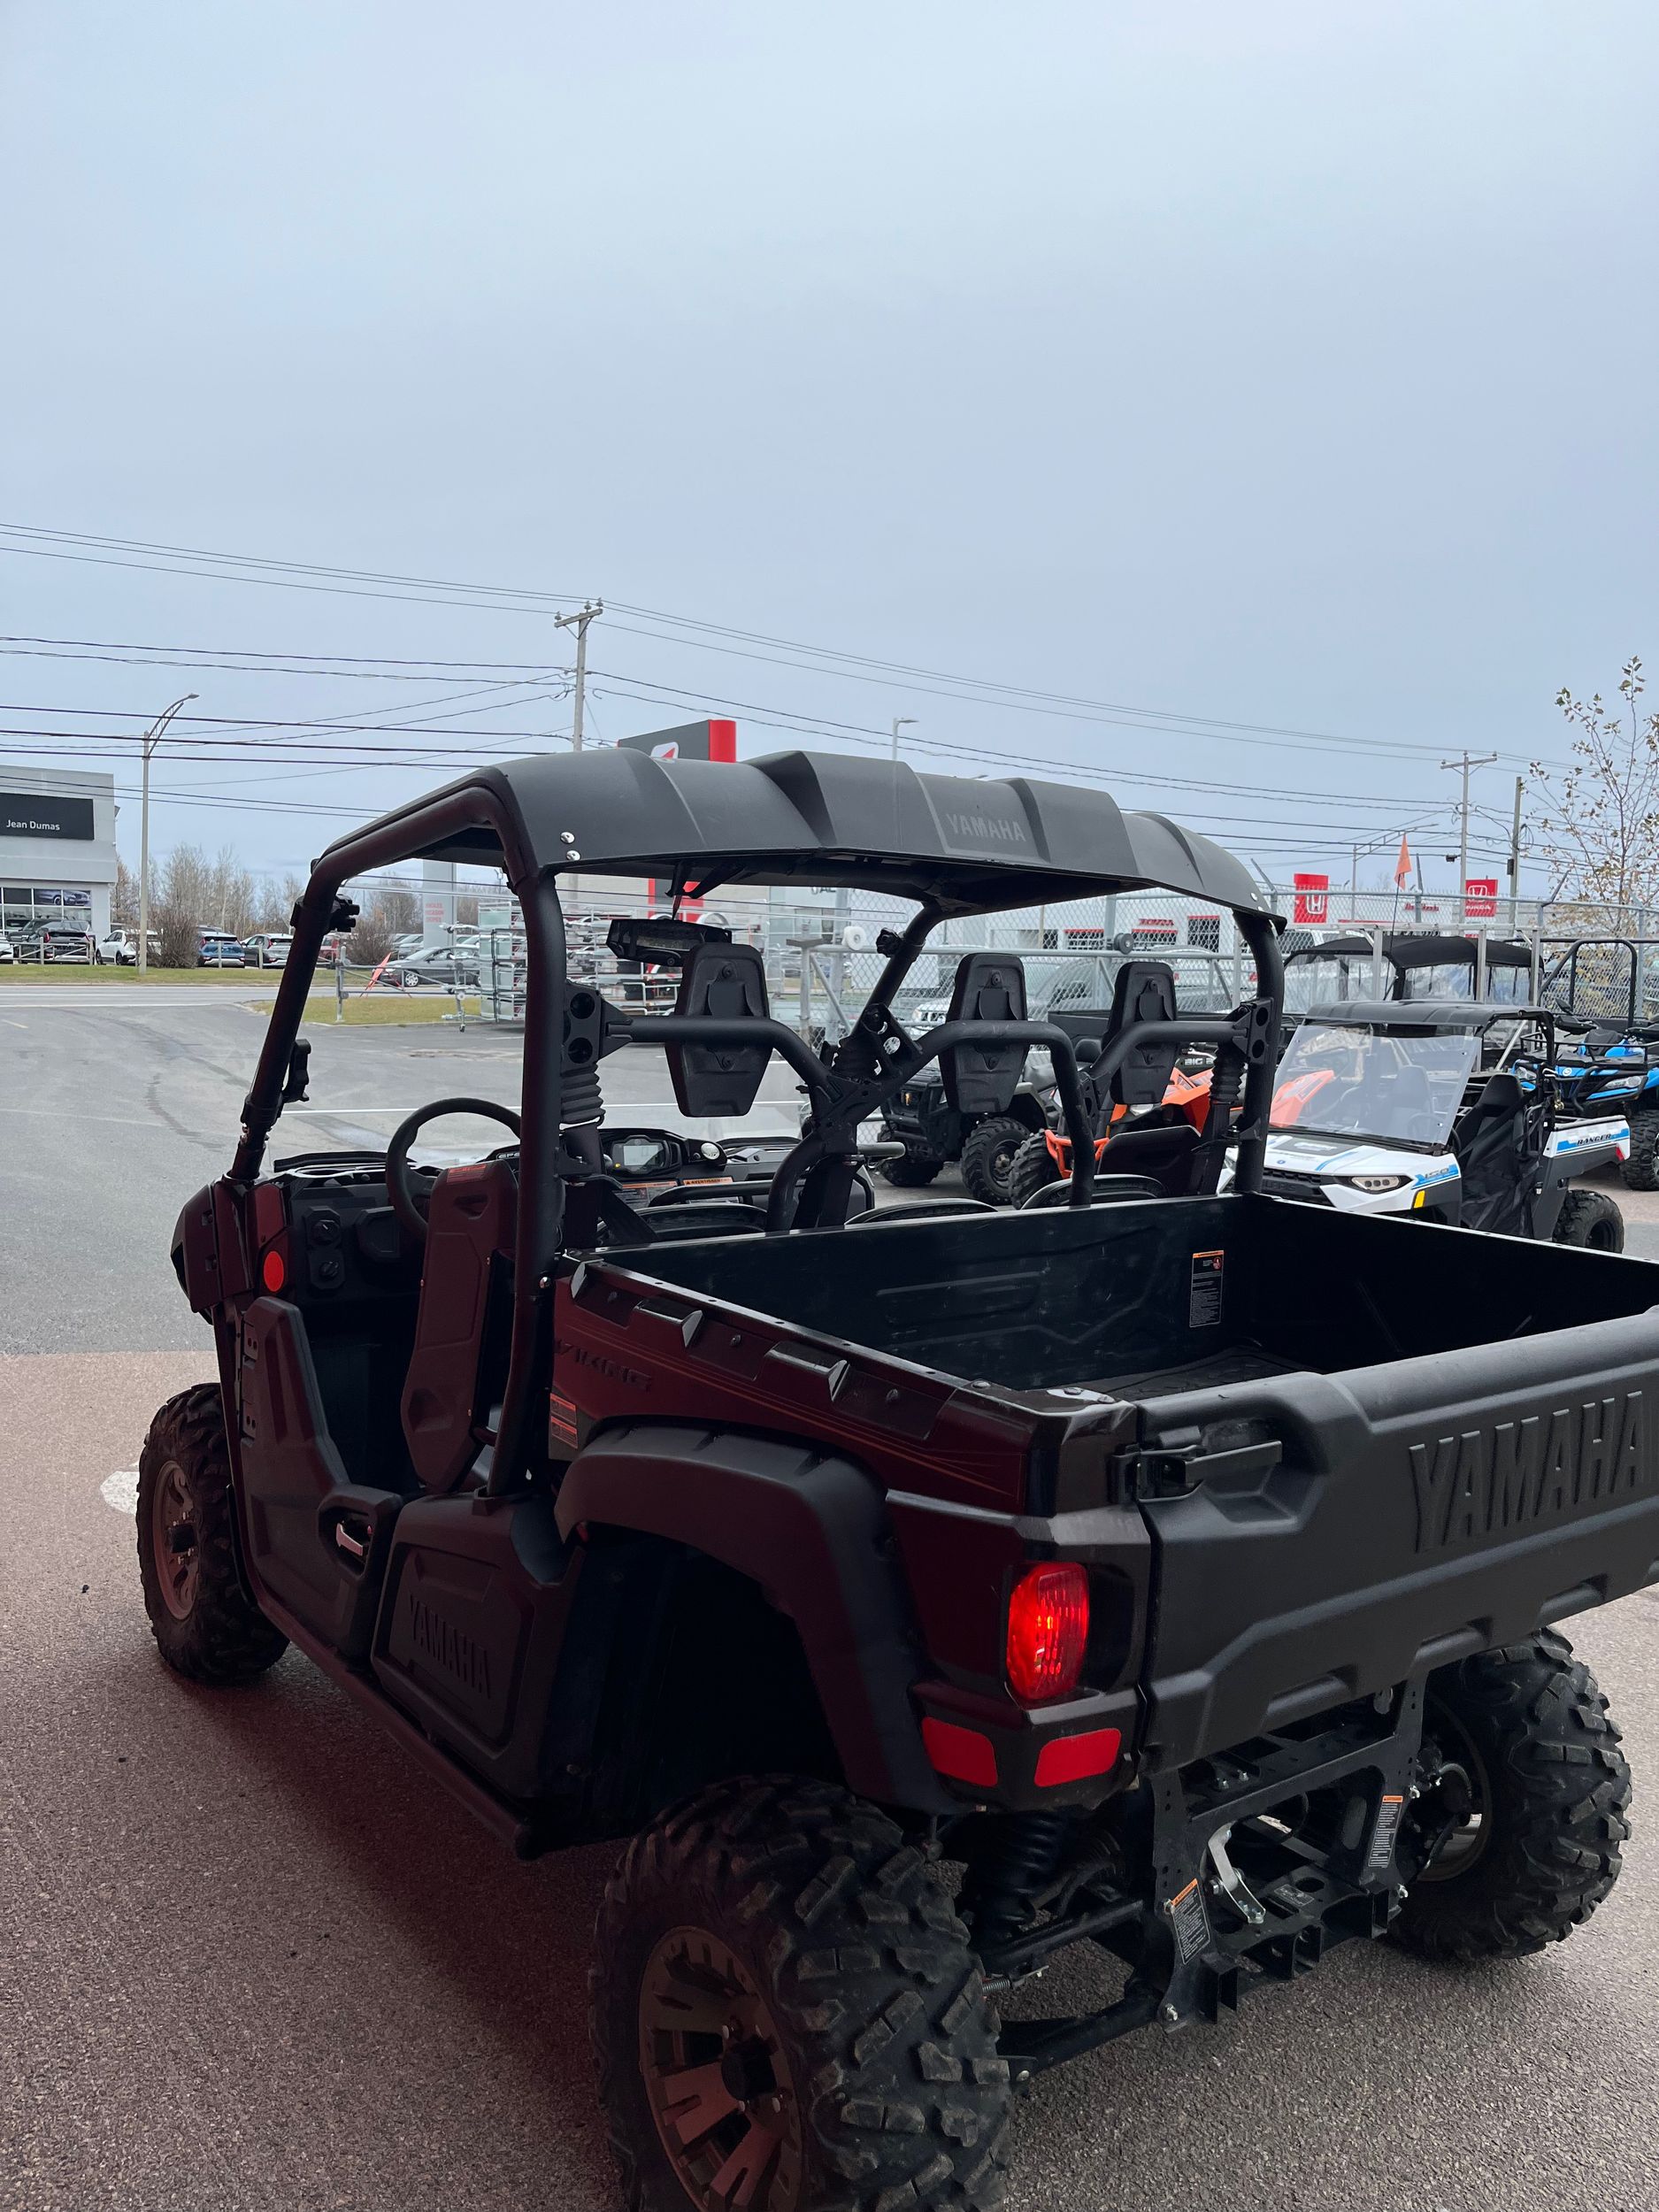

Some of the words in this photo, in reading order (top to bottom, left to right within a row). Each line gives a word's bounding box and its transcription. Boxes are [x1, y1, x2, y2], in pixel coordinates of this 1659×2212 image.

[6, 819, 27, 828] Jean
[29, 820, 60, 831] Dumas
[945, 813, 1027, 842] YAMAHA
[1184, 1057, 1203, 1066] BIG
[1576, 1133, 1612, 1146] RANGER
[1409, 1389, 1649, 1554] YAMAHA
[409, 1593, 491, 1700] YAMAHA
